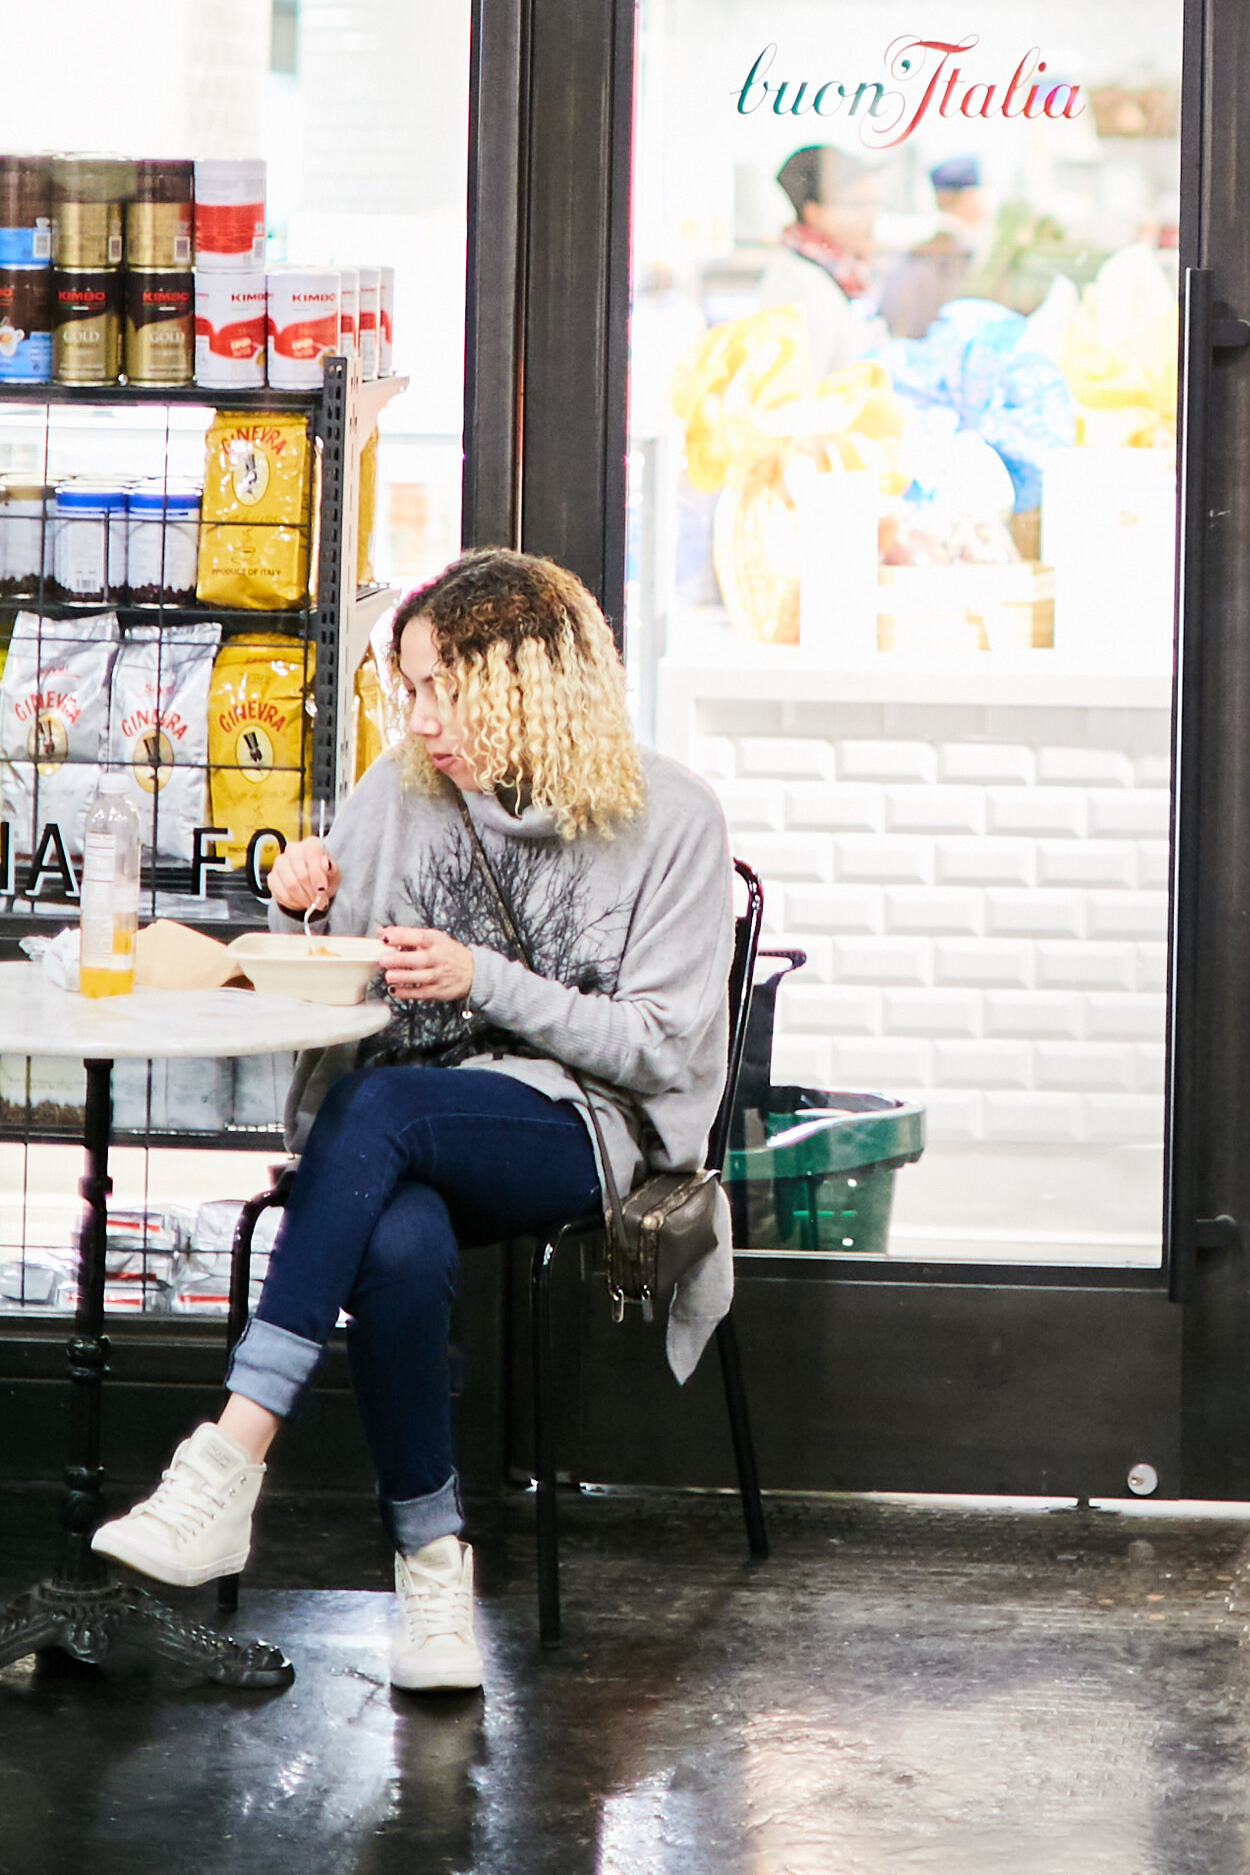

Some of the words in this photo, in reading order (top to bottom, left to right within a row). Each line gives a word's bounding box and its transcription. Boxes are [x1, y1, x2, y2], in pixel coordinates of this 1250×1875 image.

[58, 290, 106, 302] KIMBO
[142, 291, 190, 303] KIMBO
[292, 292, 337, 303] KIMBO
[63, 330, 100, 343] GOLD
[150, 330, 185, 343] GOLD
[219, 700, 286, 733] GINEVRA
